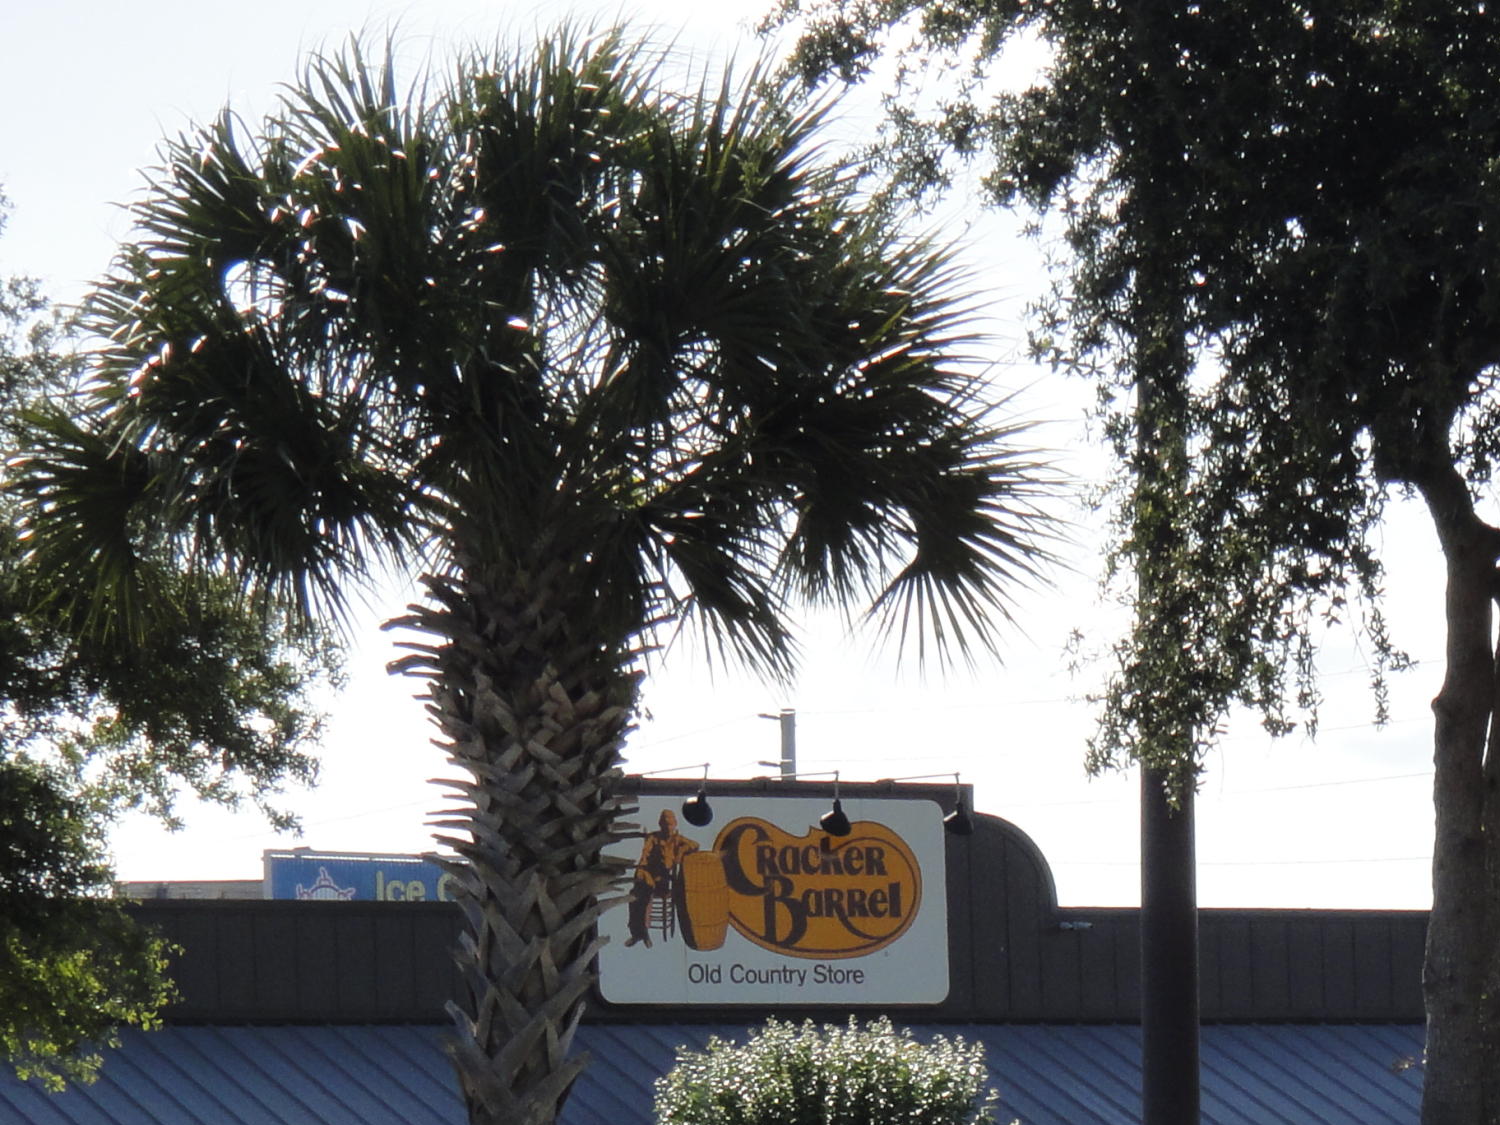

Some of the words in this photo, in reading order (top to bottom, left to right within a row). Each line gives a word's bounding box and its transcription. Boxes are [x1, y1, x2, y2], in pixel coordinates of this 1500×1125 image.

[376, 871, 425, 901] Ice
[688, 964, 722, 985] Old
[730, 965, 807, 987] Country
[813, 964, 865, 985] Store
